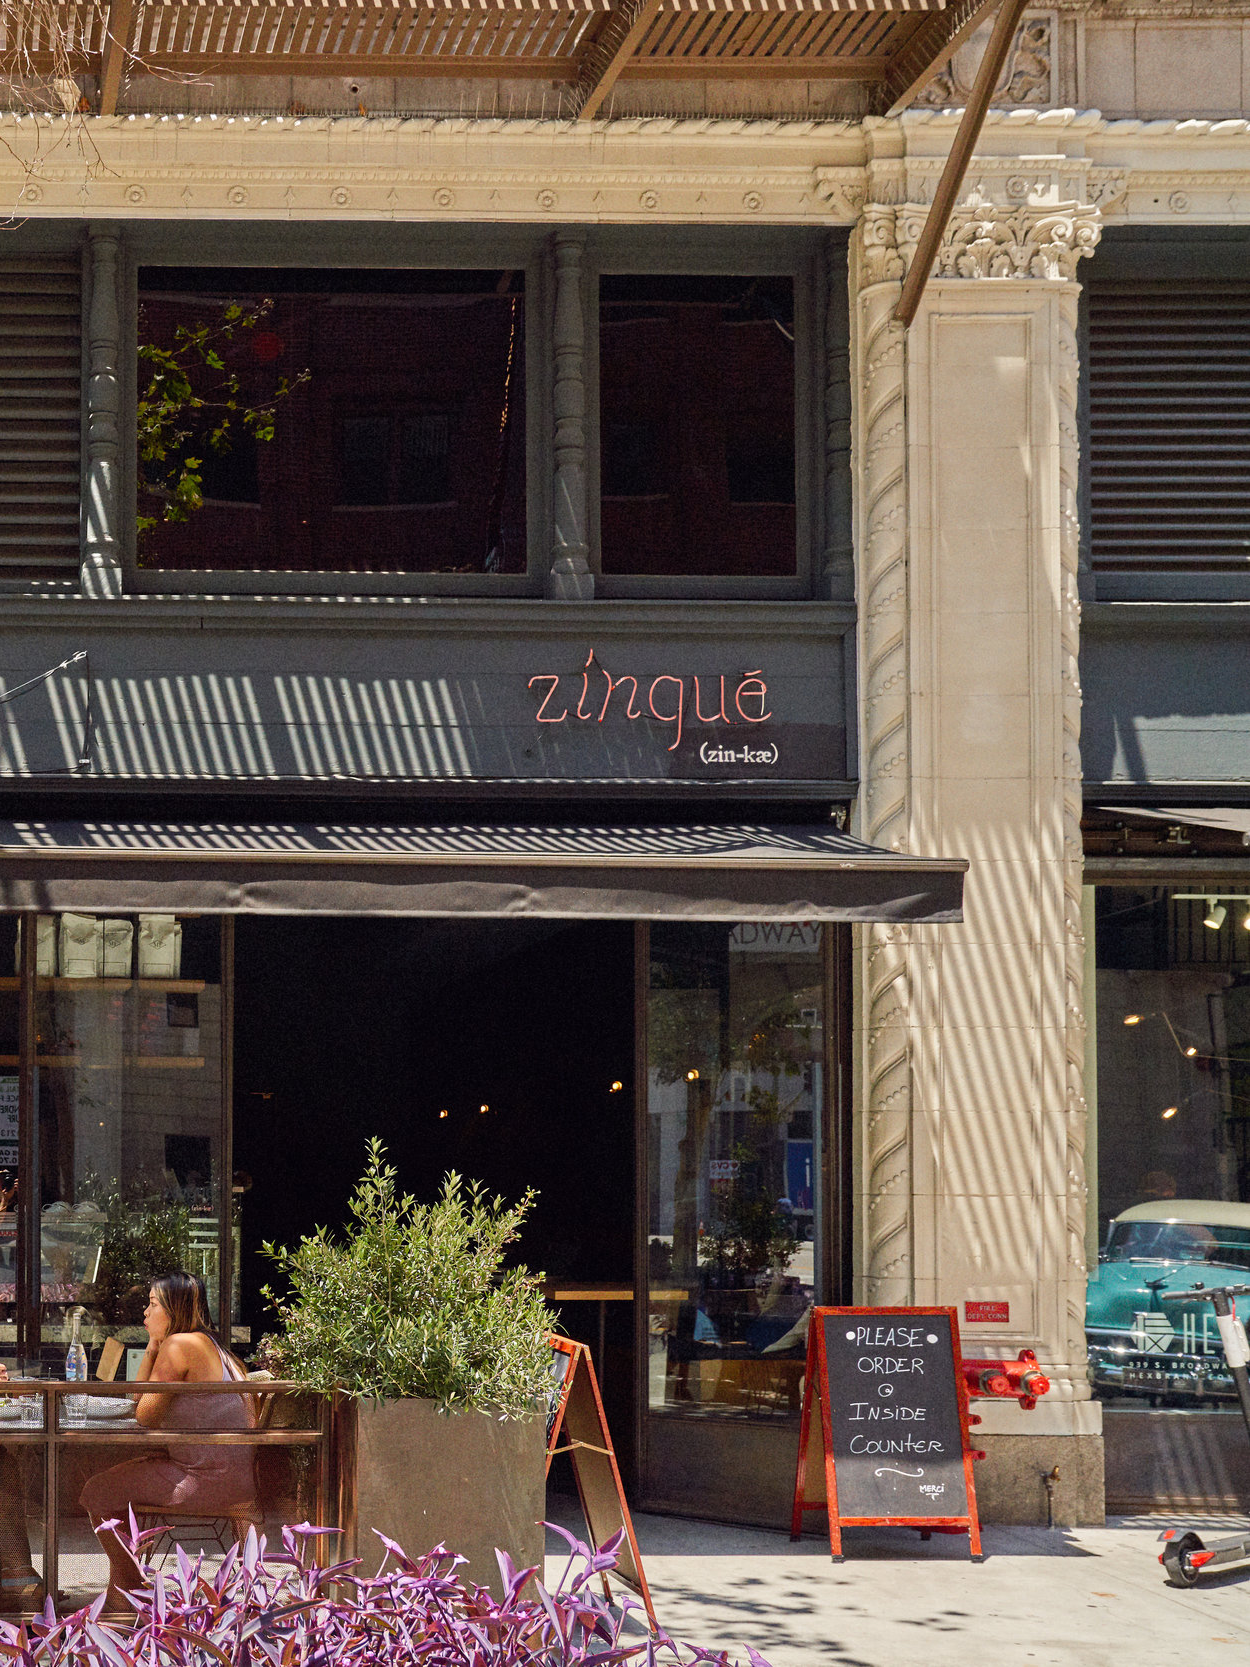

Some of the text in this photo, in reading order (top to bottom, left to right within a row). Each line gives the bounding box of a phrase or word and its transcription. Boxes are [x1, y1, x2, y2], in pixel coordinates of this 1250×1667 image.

[698, 741, 780, 765] (zin-kæ)
[856, 1326, 924, 1347] PLEASE
[1182, 1312, 1216, 1355] HE
[857, 1356, 924, 1375] ORDER
[1128, 1361, 1149, 1369] 939
